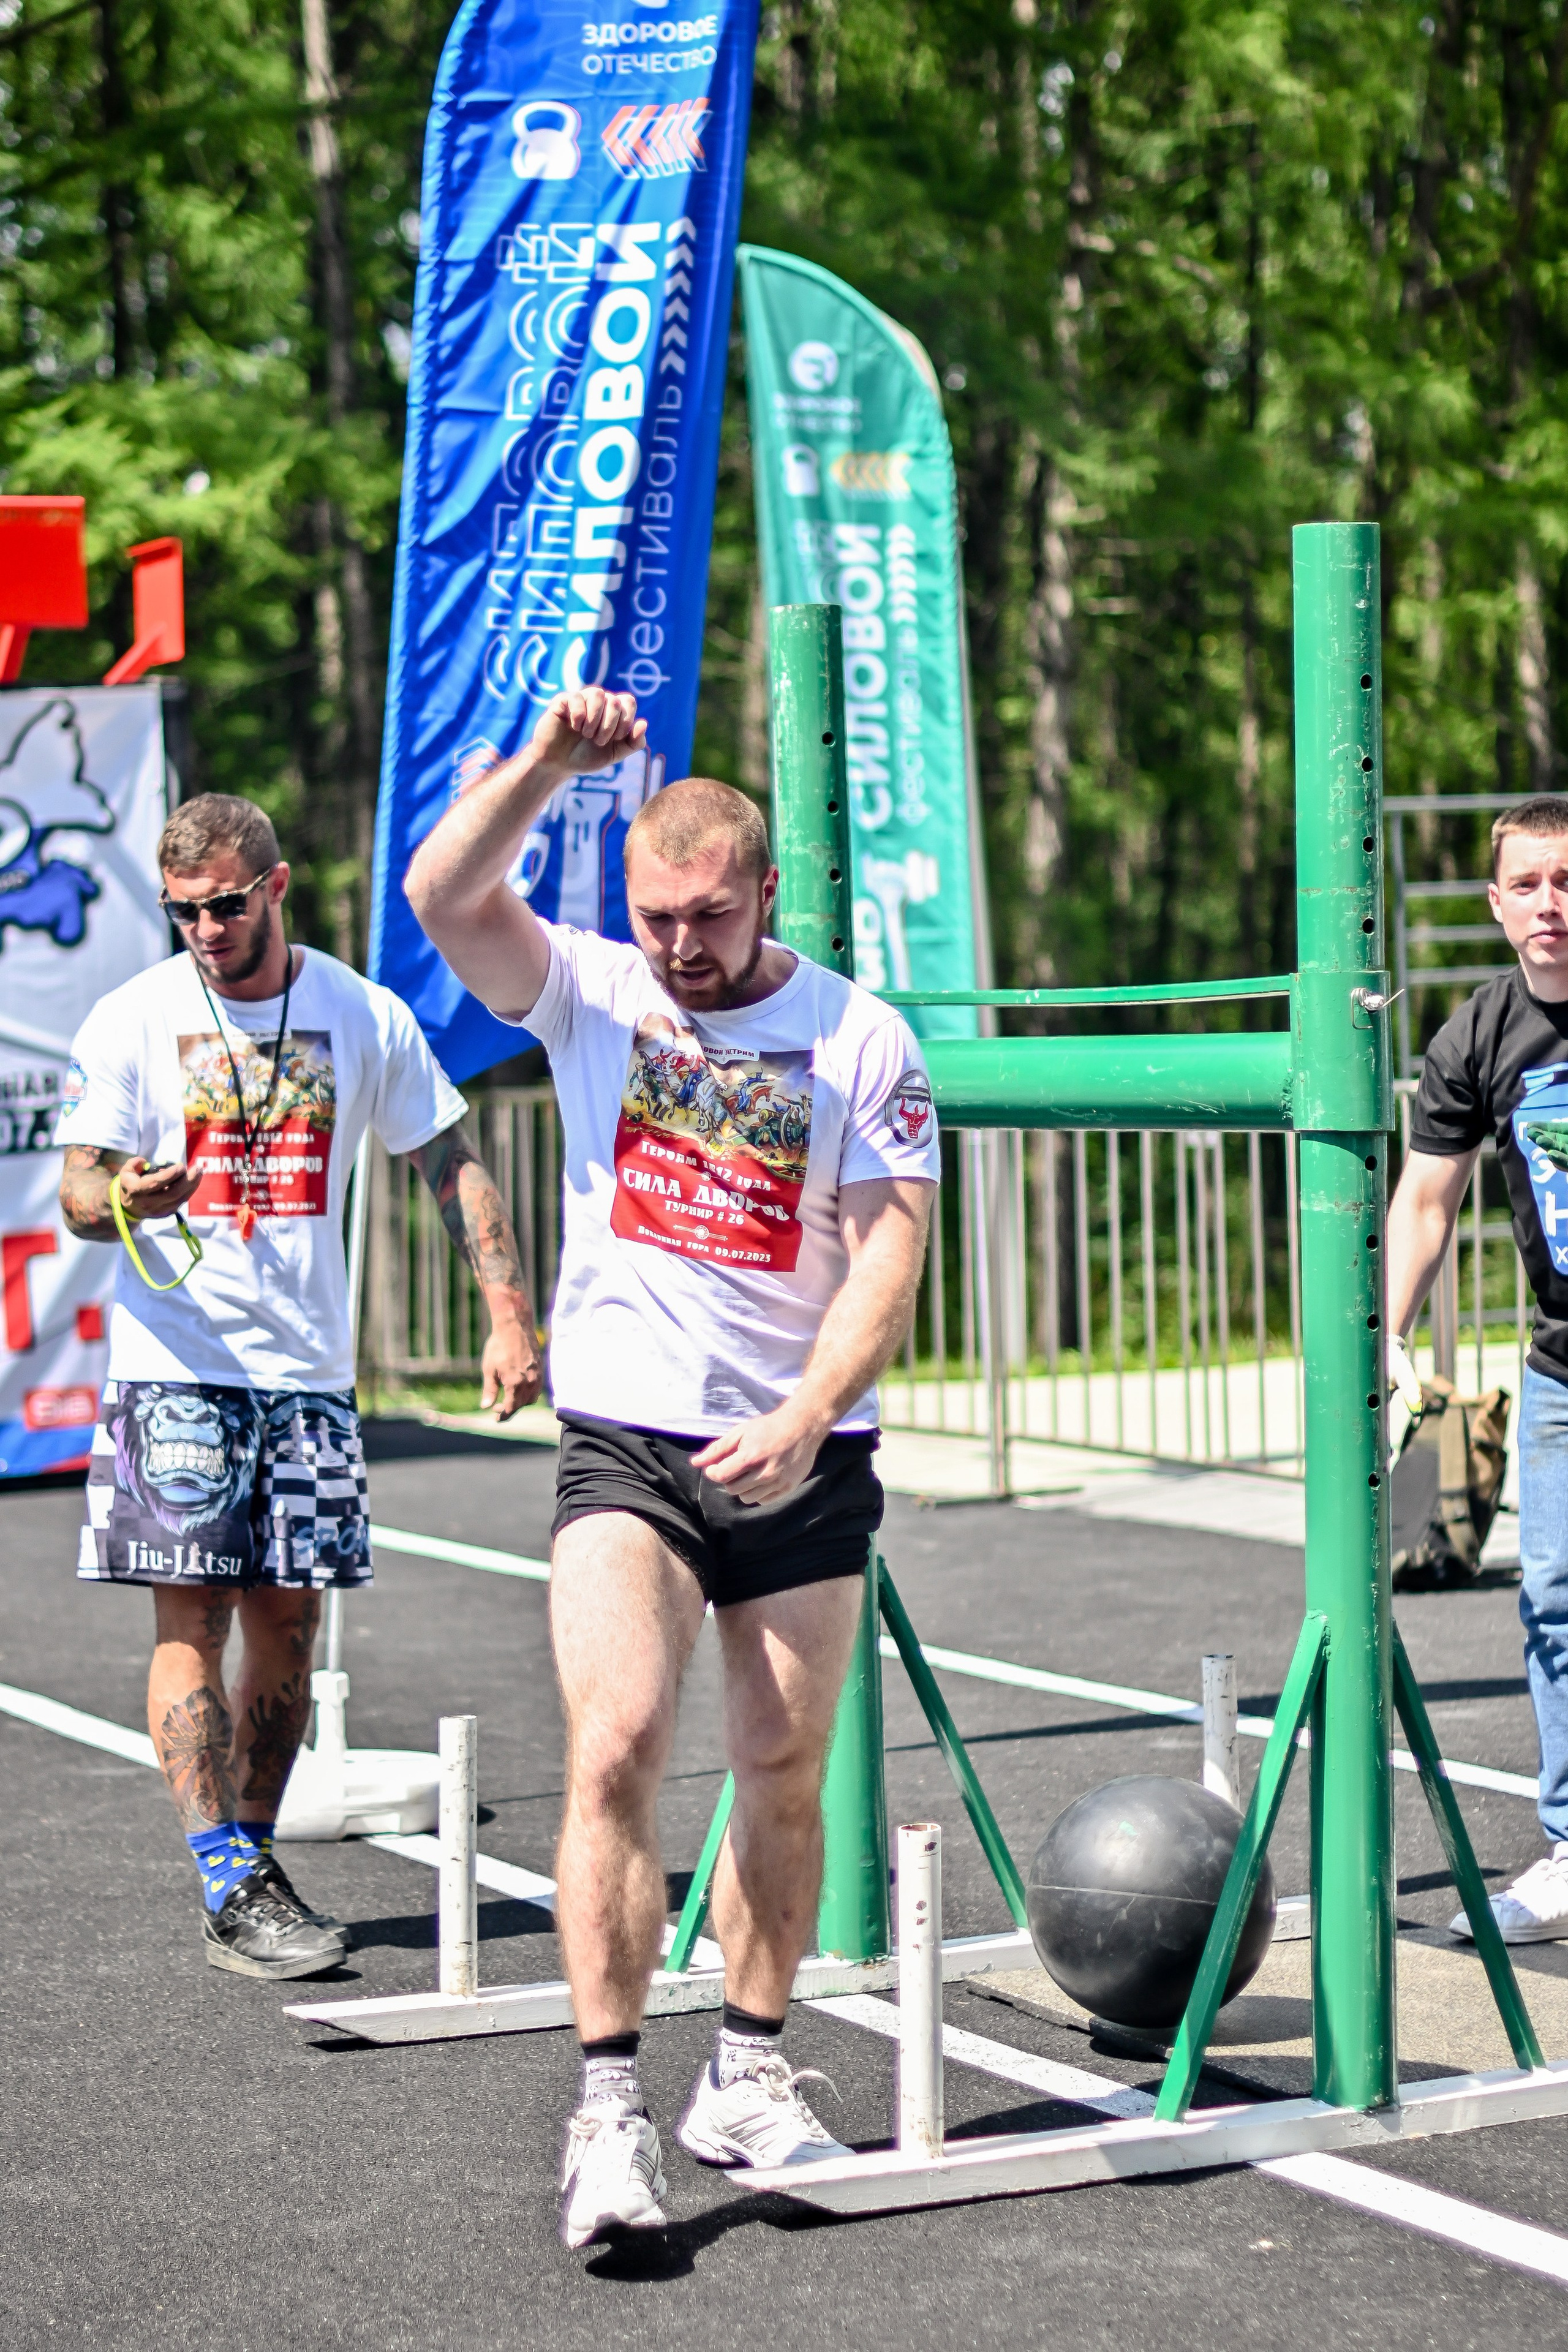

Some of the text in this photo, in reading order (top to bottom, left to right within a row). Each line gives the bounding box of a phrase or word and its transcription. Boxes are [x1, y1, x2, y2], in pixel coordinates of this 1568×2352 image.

[582, 15, 718, 47] ЗДОРОВОЕ
[582, 45, 717, 75] ОТЕЧЕСТВО
[562, 221, 661, 693] СИЛОВОЙ
[617, 385, 682, 698] фестиваль
[836, 524, 892, 829] СИЛОВОЙ
[701, 1046, 723, 1055] ОВОЙ
[624, 1167, 682, 1198] СИЛА
[641, 1140, 771, 1191] ГЕРОЯМ 1812 ГОДА
[665, 1200, 745, 1225] ТУРНИР # 26
[638, 1224, 771, 1262] ПОКЛОННАЯ ГОРА 09.07.2023
